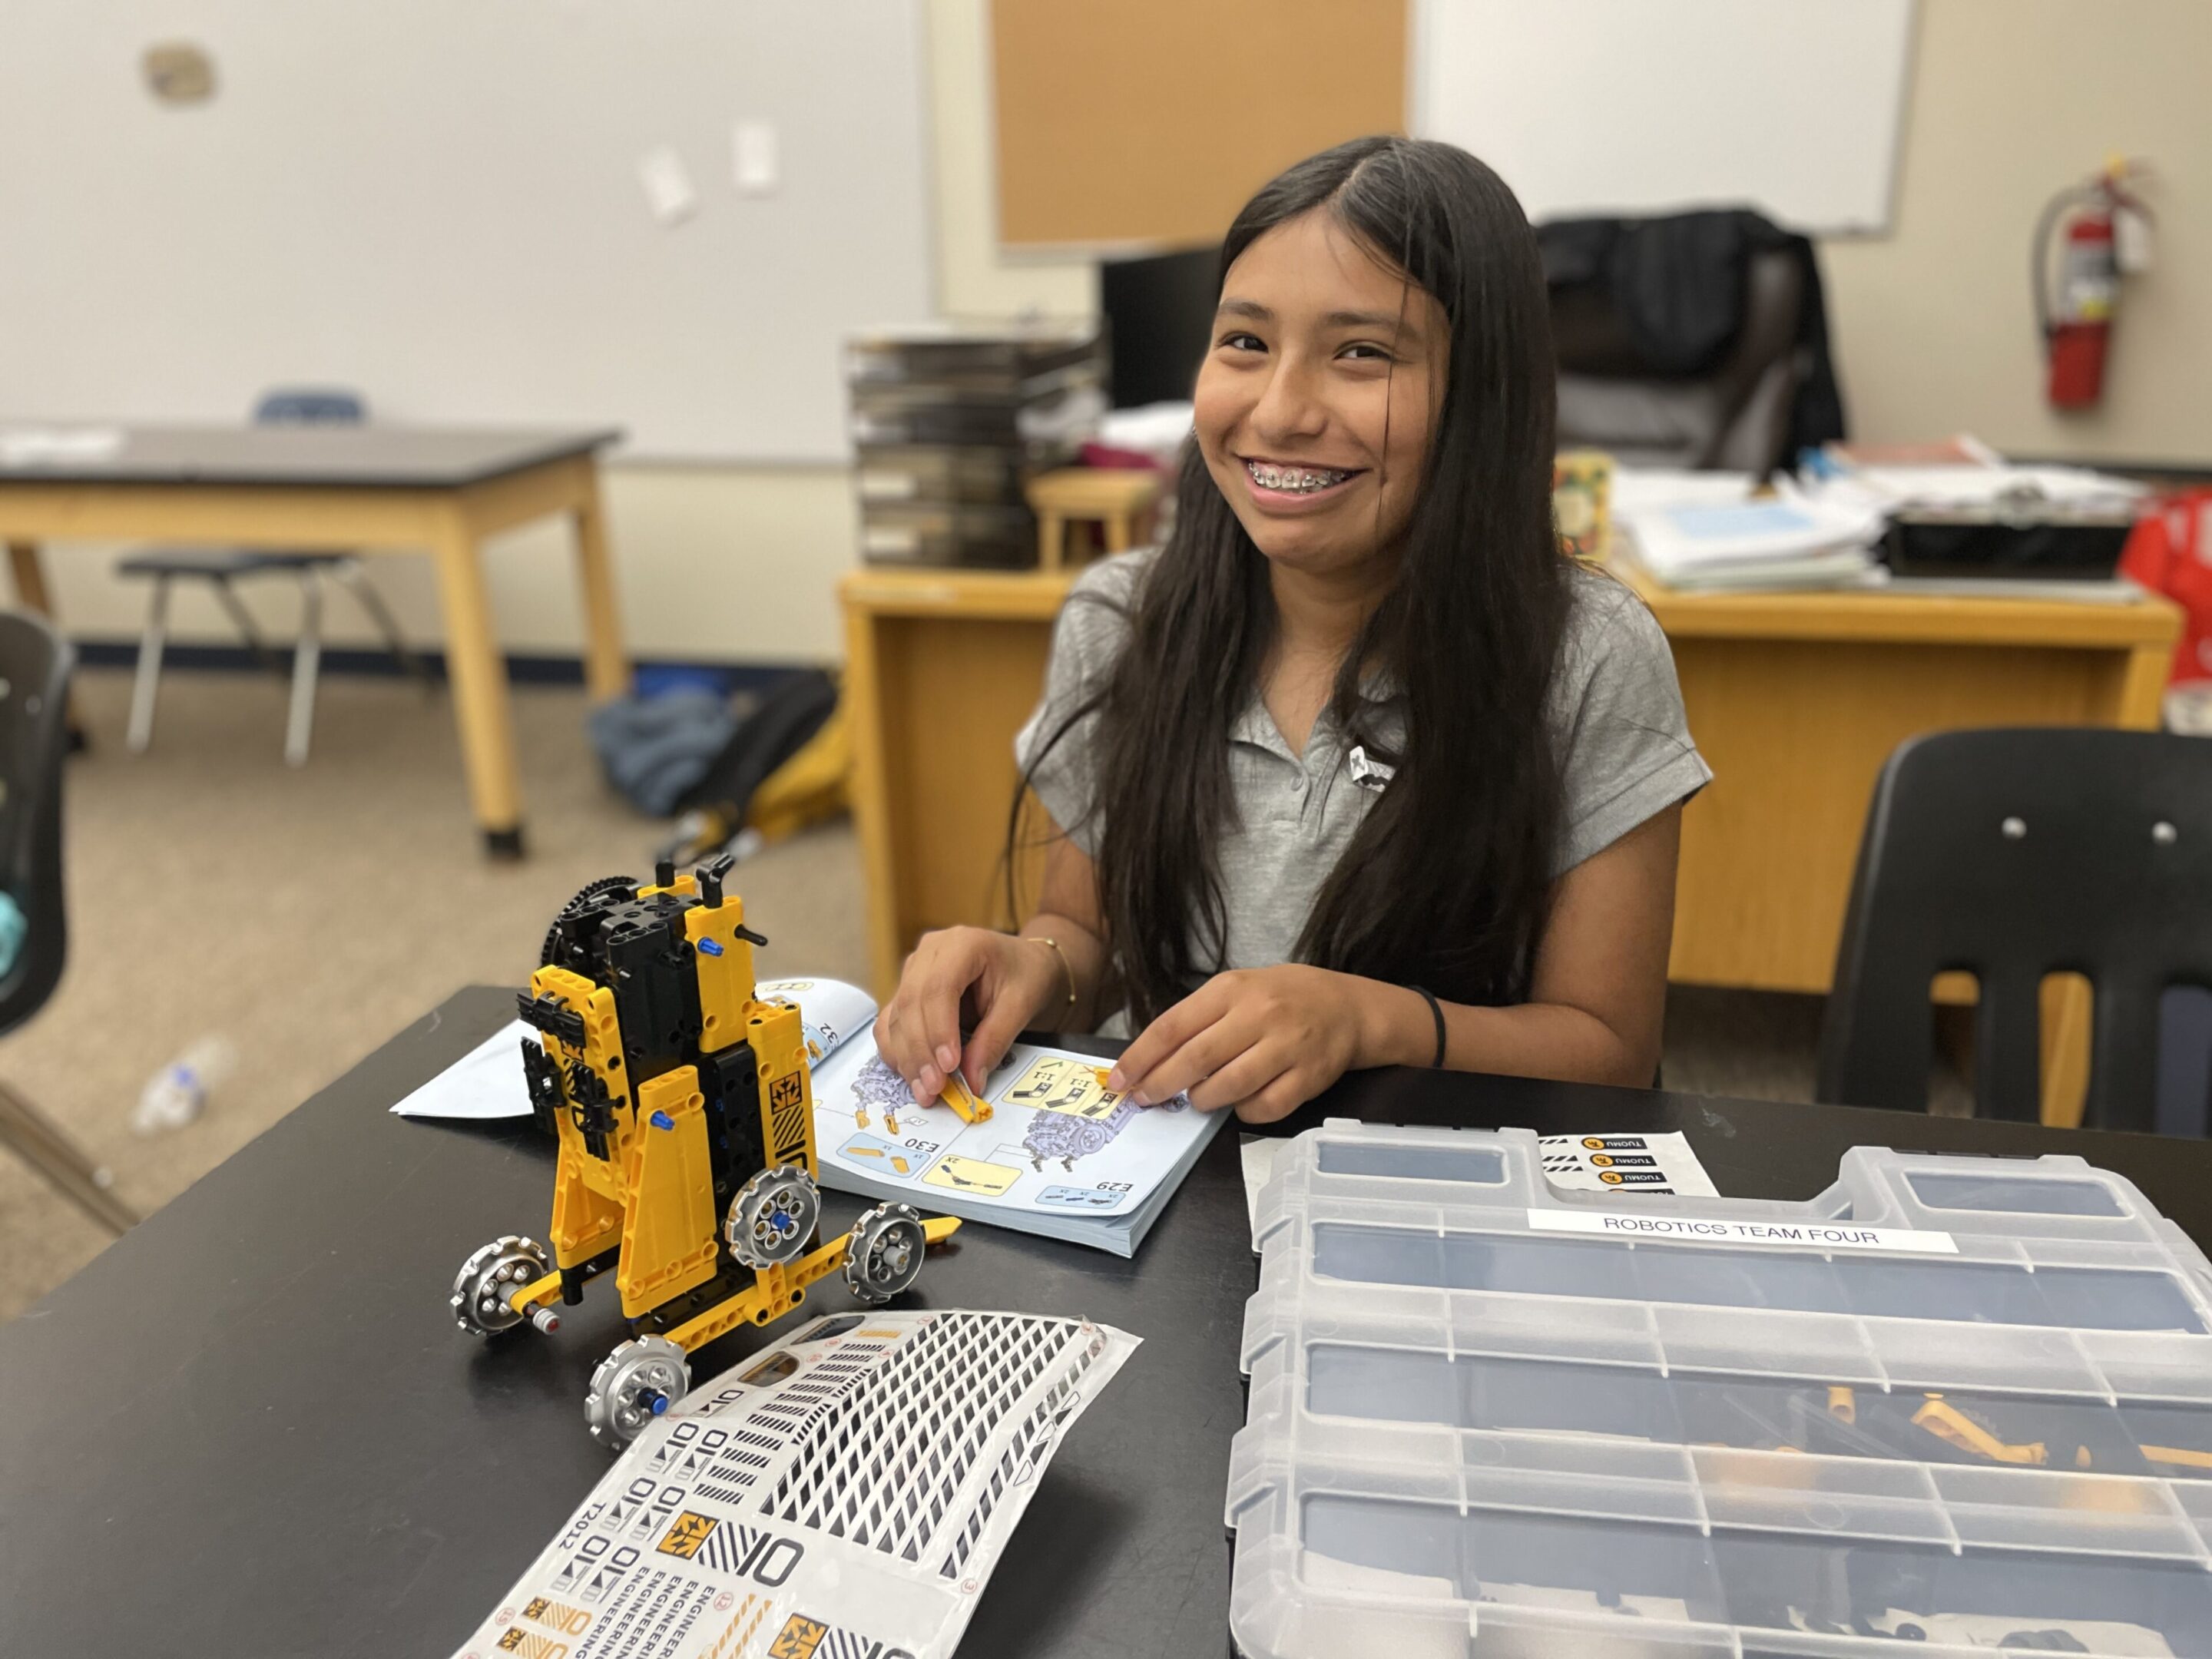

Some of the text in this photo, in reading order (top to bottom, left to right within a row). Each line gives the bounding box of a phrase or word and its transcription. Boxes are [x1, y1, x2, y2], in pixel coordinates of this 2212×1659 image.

[905, 1138, 940, 1153] E30
[1096, 1181, 1134, 1192] E29
[1603, 1217, 1880, 1245] ROBOTICS TEAM FOUR
[558, 1502, 607, 1549] T2012
[594, 1571, 667, 1659] ENGINEERIN
